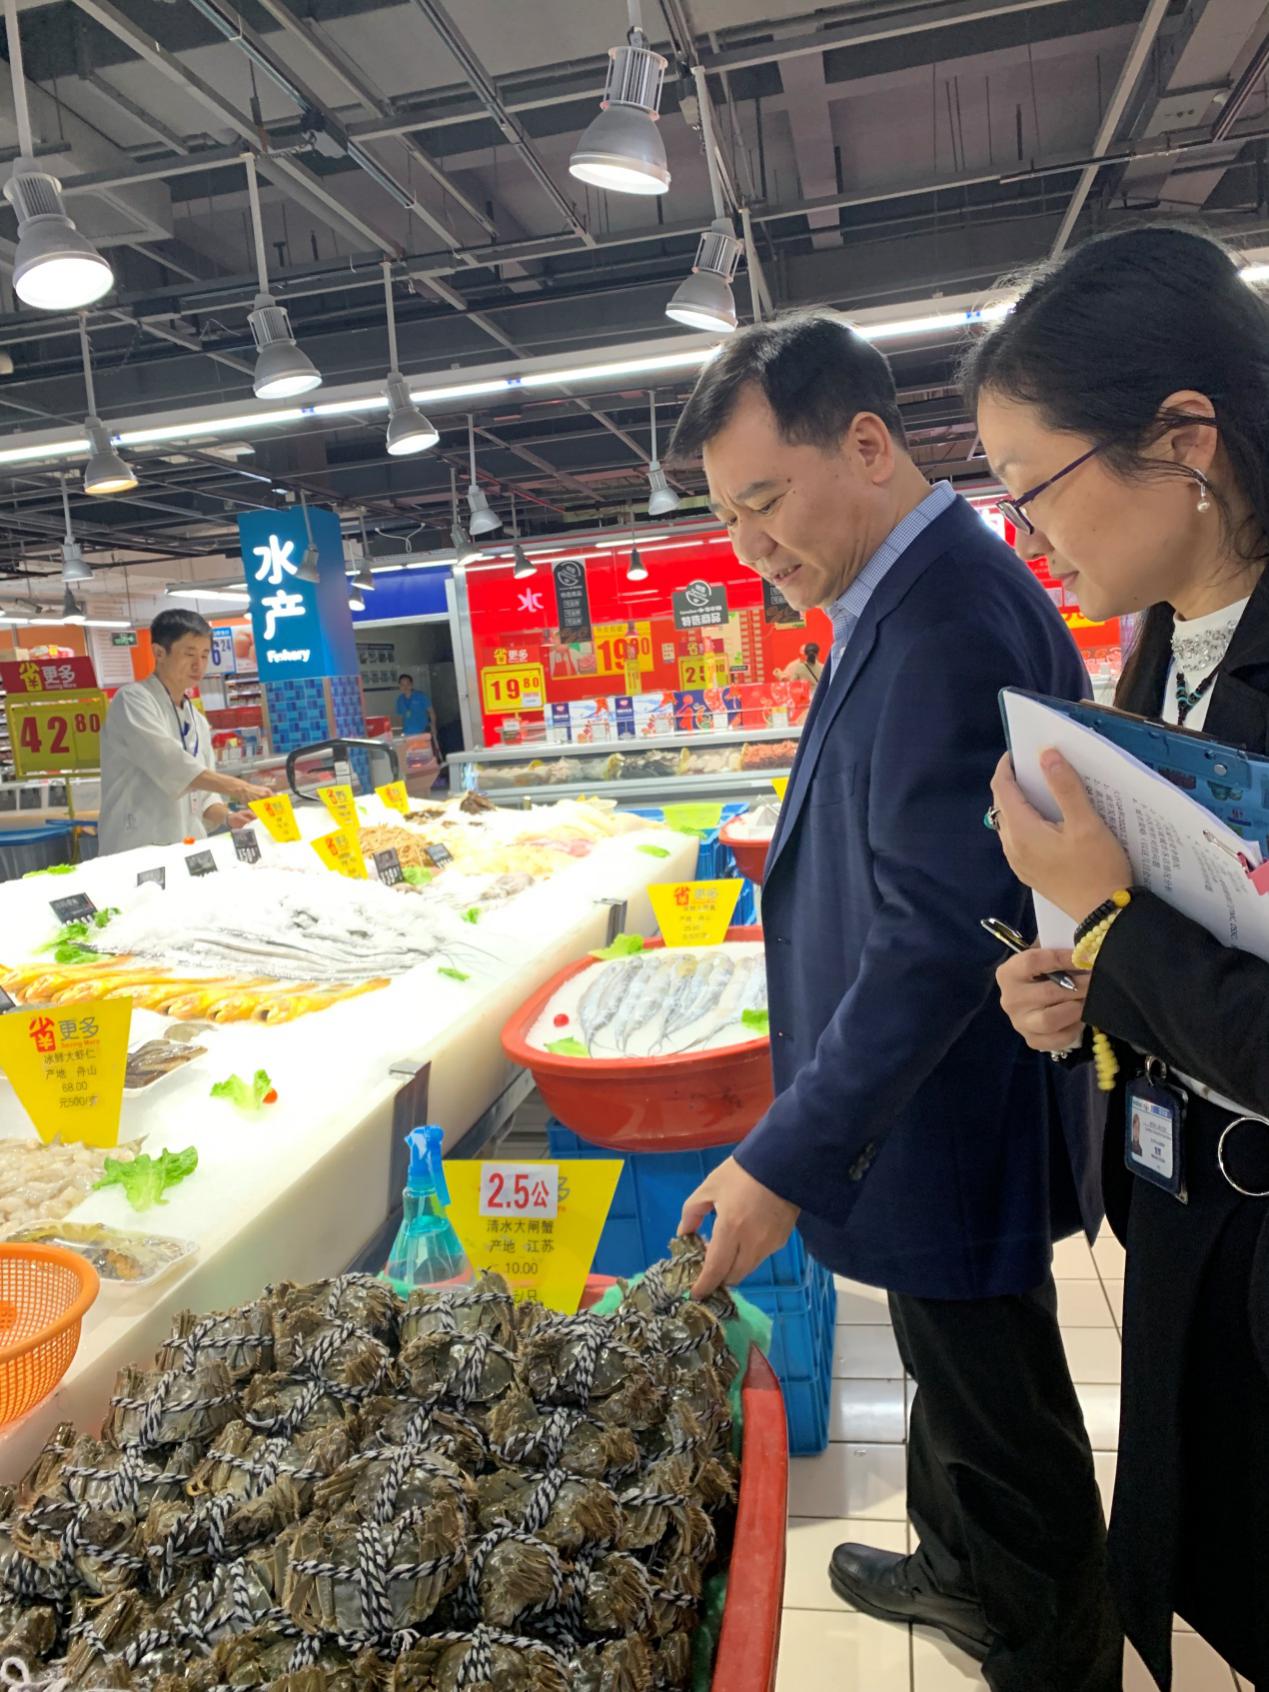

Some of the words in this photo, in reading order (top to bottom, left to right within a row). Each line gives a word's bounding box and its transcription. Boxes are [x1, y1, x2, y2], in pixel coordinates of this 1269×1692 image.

[253, 534, 306, 640] 水产
[29, 1016, 99, 1053] 省更多
[487, 1219, 554, 1234] 清水大闸蟹
[489, 1240, 515, 1254] 产地
[528, 1239, 554, 1253] 江苏
[505, 1263, 538, 1275] 10.00
